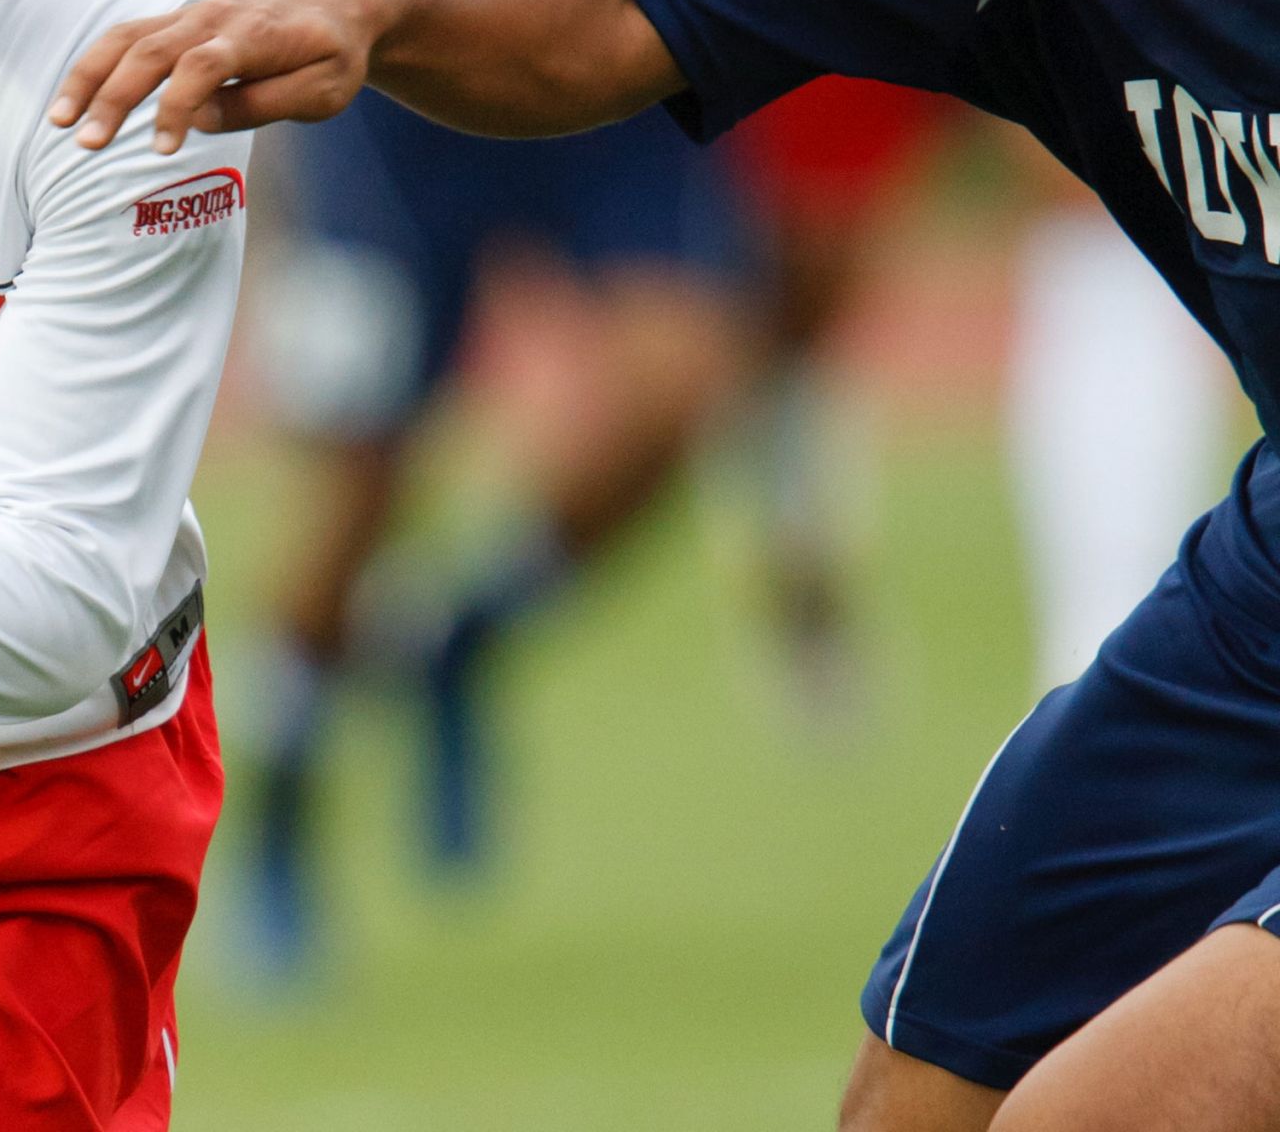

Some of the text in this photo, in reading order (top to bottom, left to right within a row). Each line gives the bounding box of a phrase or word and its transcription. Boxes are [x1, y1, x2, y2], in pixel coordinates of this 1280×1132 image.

[134, 180, 235, 227] BIG SOUTH
[133, 208, 232, 236] CONFERENCE
[169, 615, 189, 649] M
[134, 670, 164, 699] TEAM
